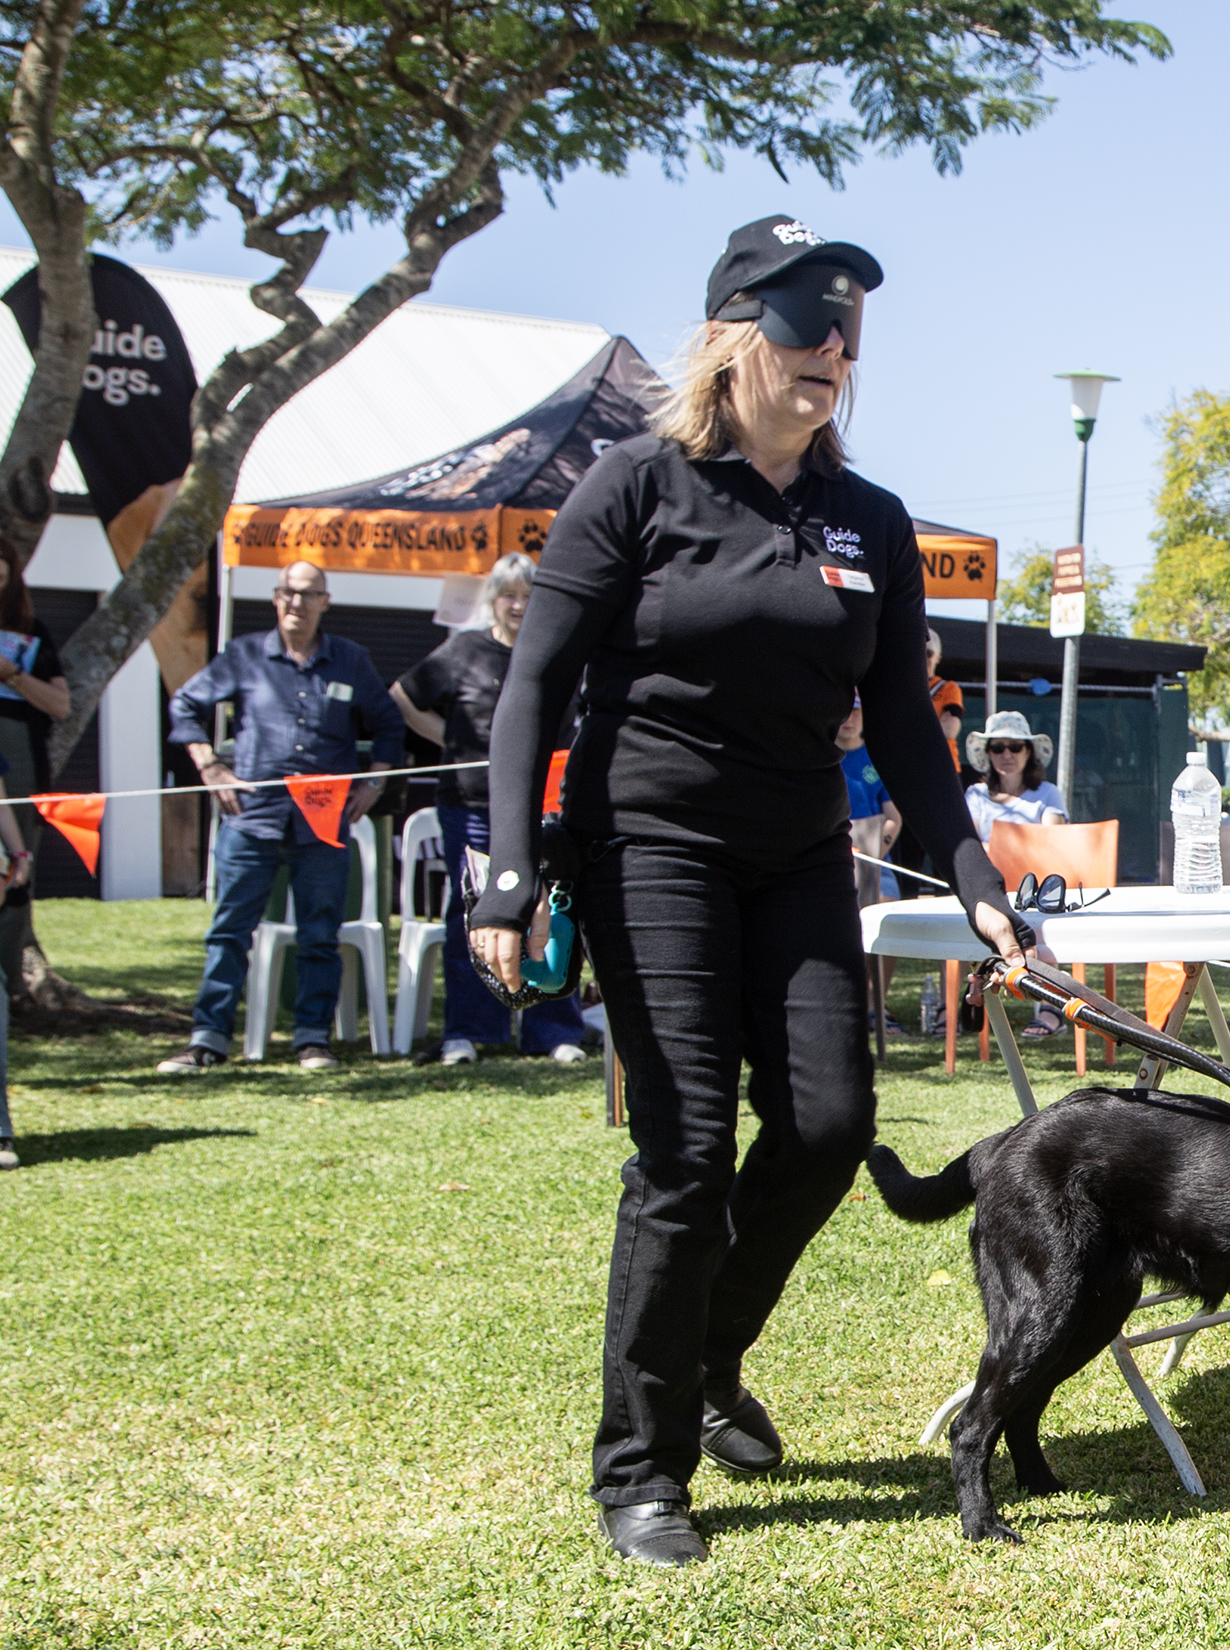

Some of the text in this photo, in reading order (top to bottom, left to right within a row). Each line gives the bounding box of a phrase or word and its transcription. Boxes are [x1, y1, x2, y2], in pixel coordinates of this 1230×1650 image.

[90, 319, 167, 361] uide
[82, 364, 161, 406] ogs.
[347, 522, 467, 551] QUEENSLAND
[823, 526, 861, 543] Guide
[826, 539, 864, 559] Dogs.
